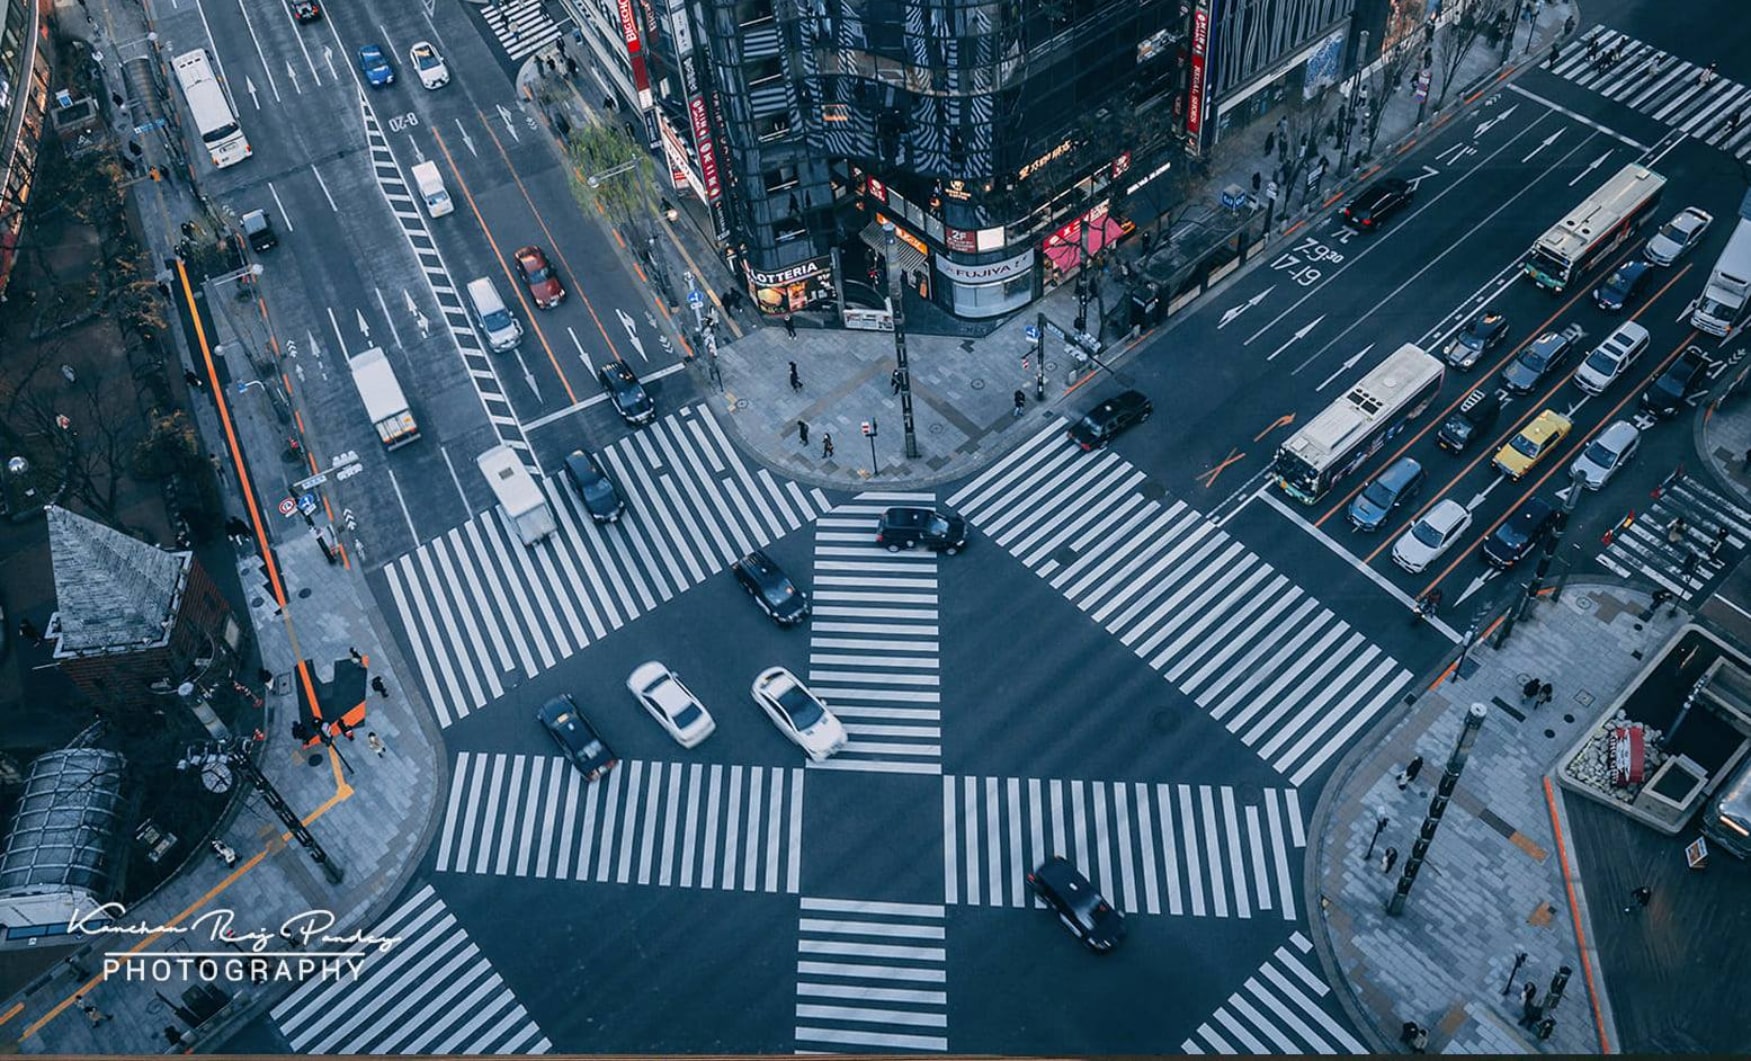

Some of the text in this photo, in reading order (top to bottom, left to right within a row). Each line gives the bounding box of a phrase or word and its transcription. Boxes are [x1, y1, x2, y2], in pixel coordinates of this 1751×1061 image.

[624, 23, 637, 42] BIG
[388, 112, 419, 133] 8-20
[751, 262, 818, 284] LOTTERIA
[956, 264, 1011, 279] FUJIYA
[1270, 253, 1321, 286] 17-19
